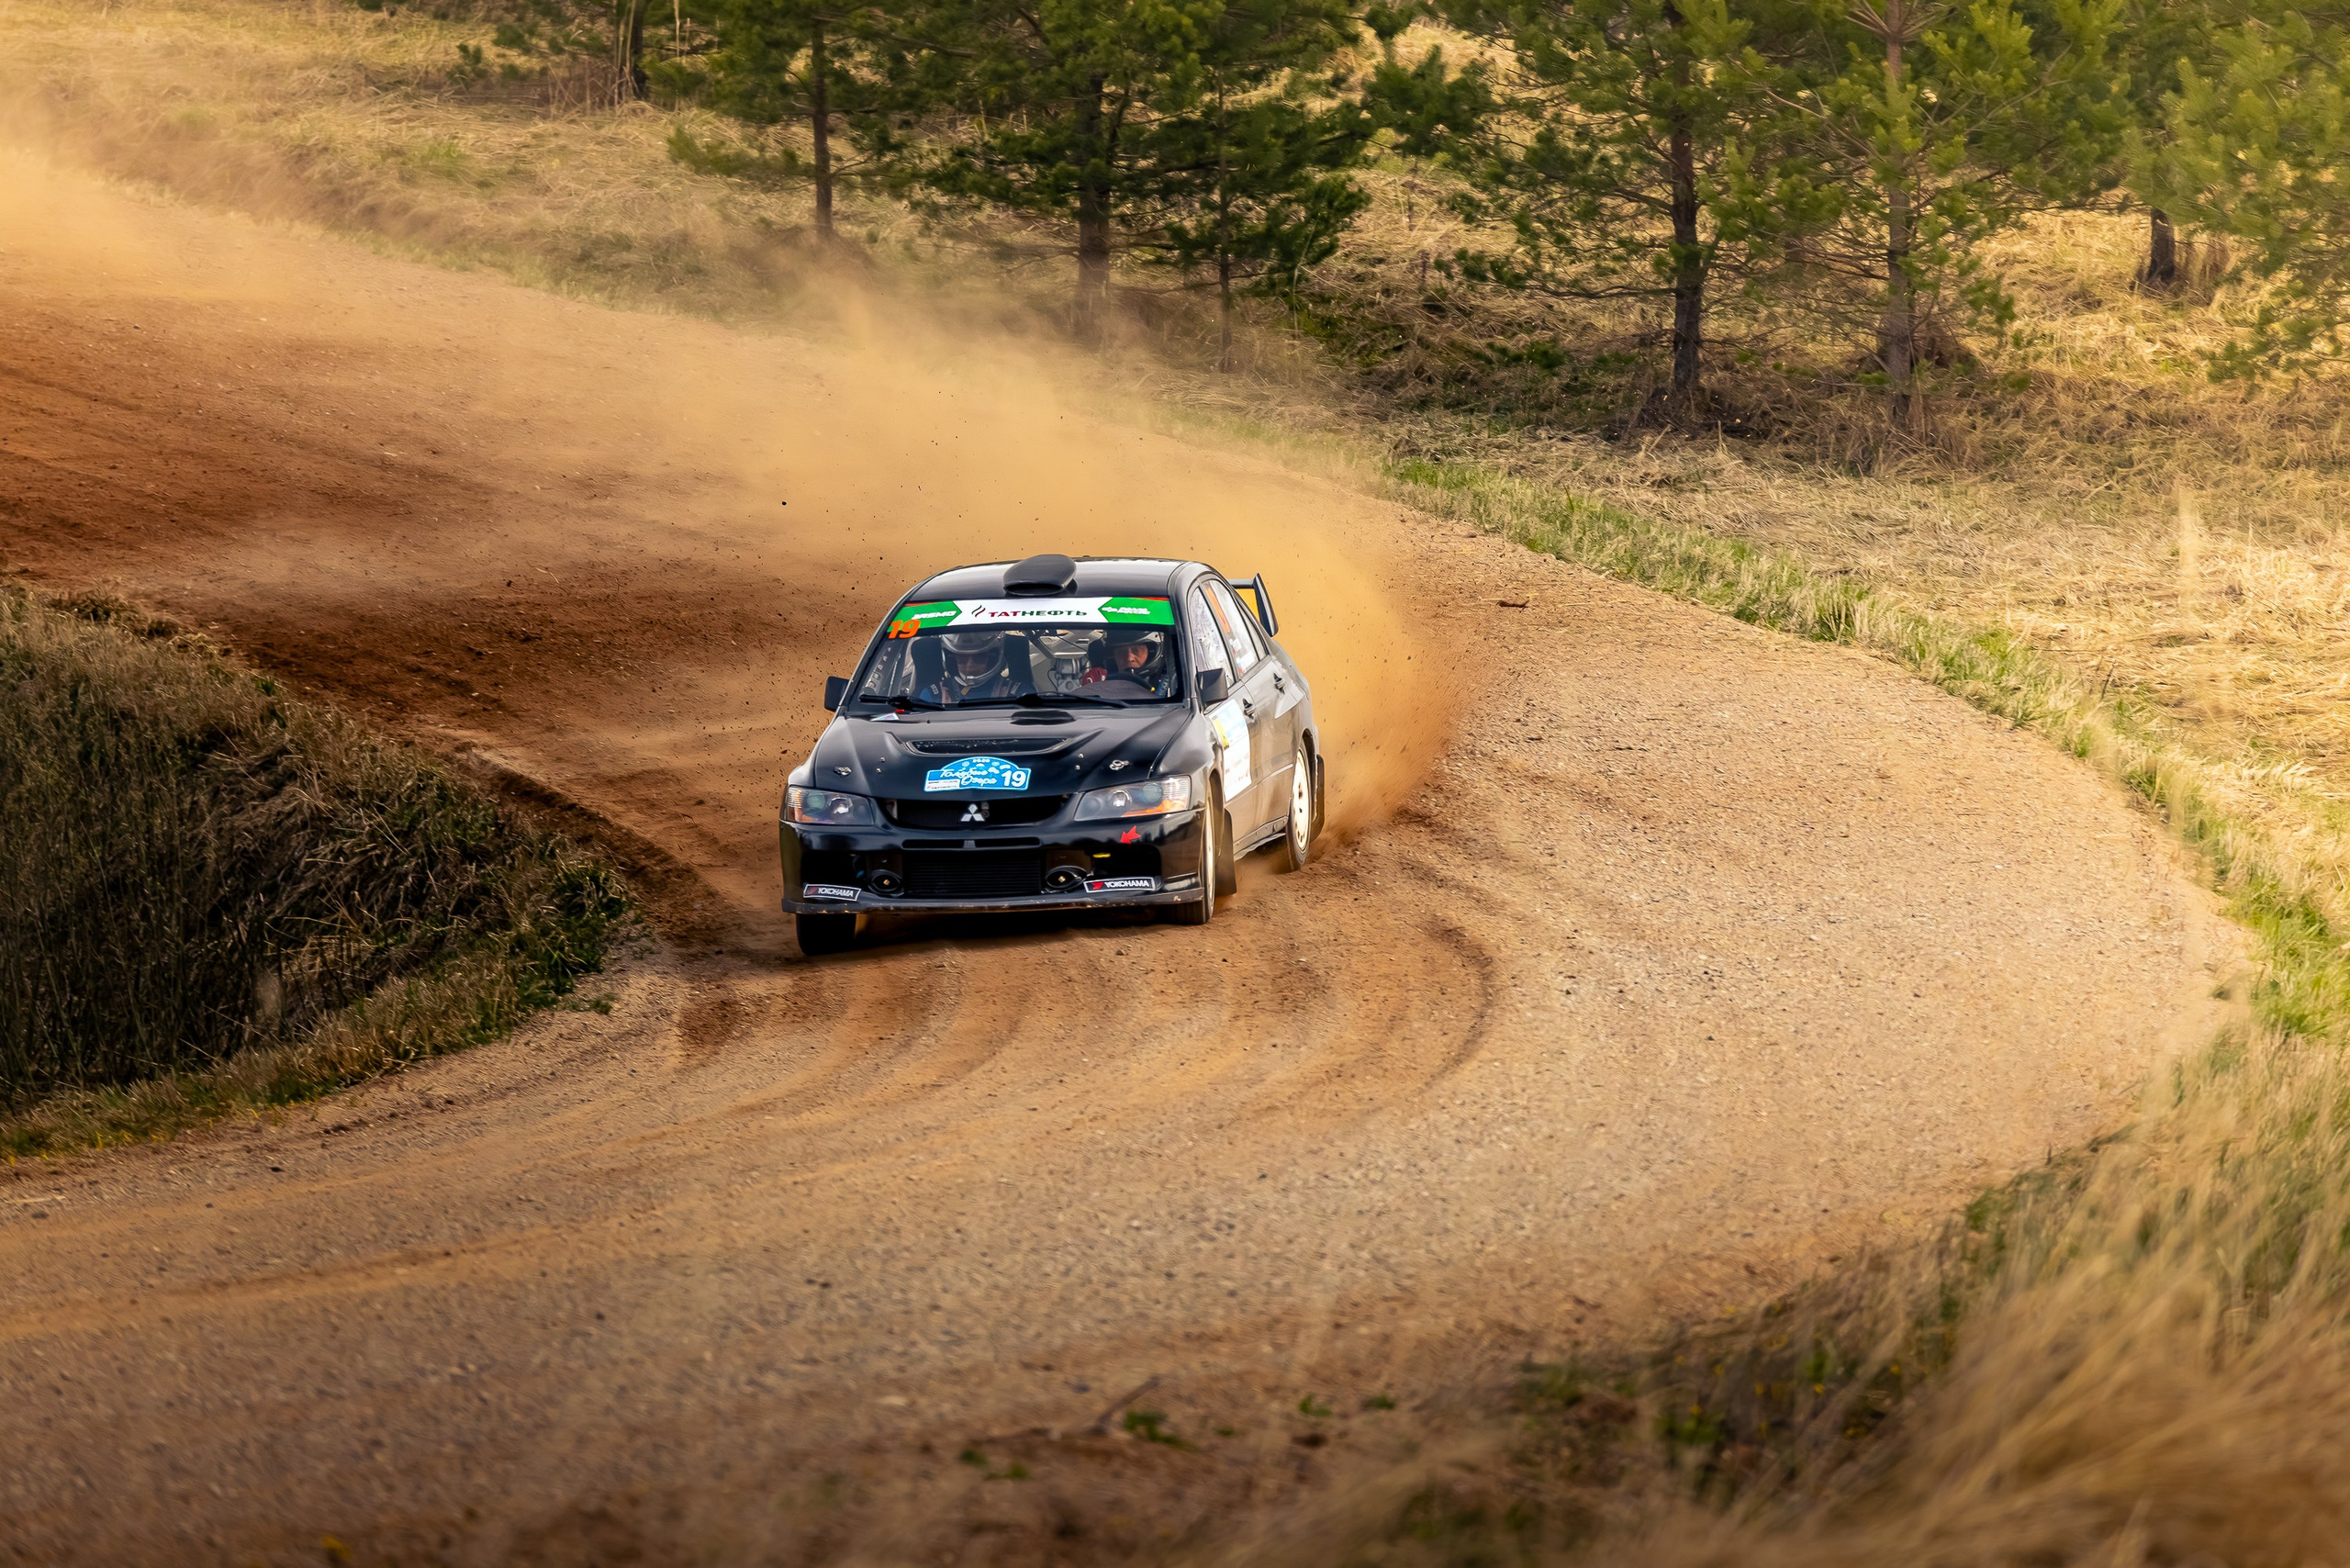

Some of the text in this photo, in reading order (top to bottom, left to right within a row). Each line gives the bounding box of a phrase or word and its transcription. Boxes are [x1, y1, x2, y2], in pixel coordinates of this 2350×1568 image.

[988, 610, 1088, 618] ТАТНЕФТЬ
[888, 619, 921, 639] 19
[1001, 770, 1027, 788] 19
[1103, 879, 1150, 888] YOKOHAMA
[817, 887, 855, 897] YOKOHAMA
